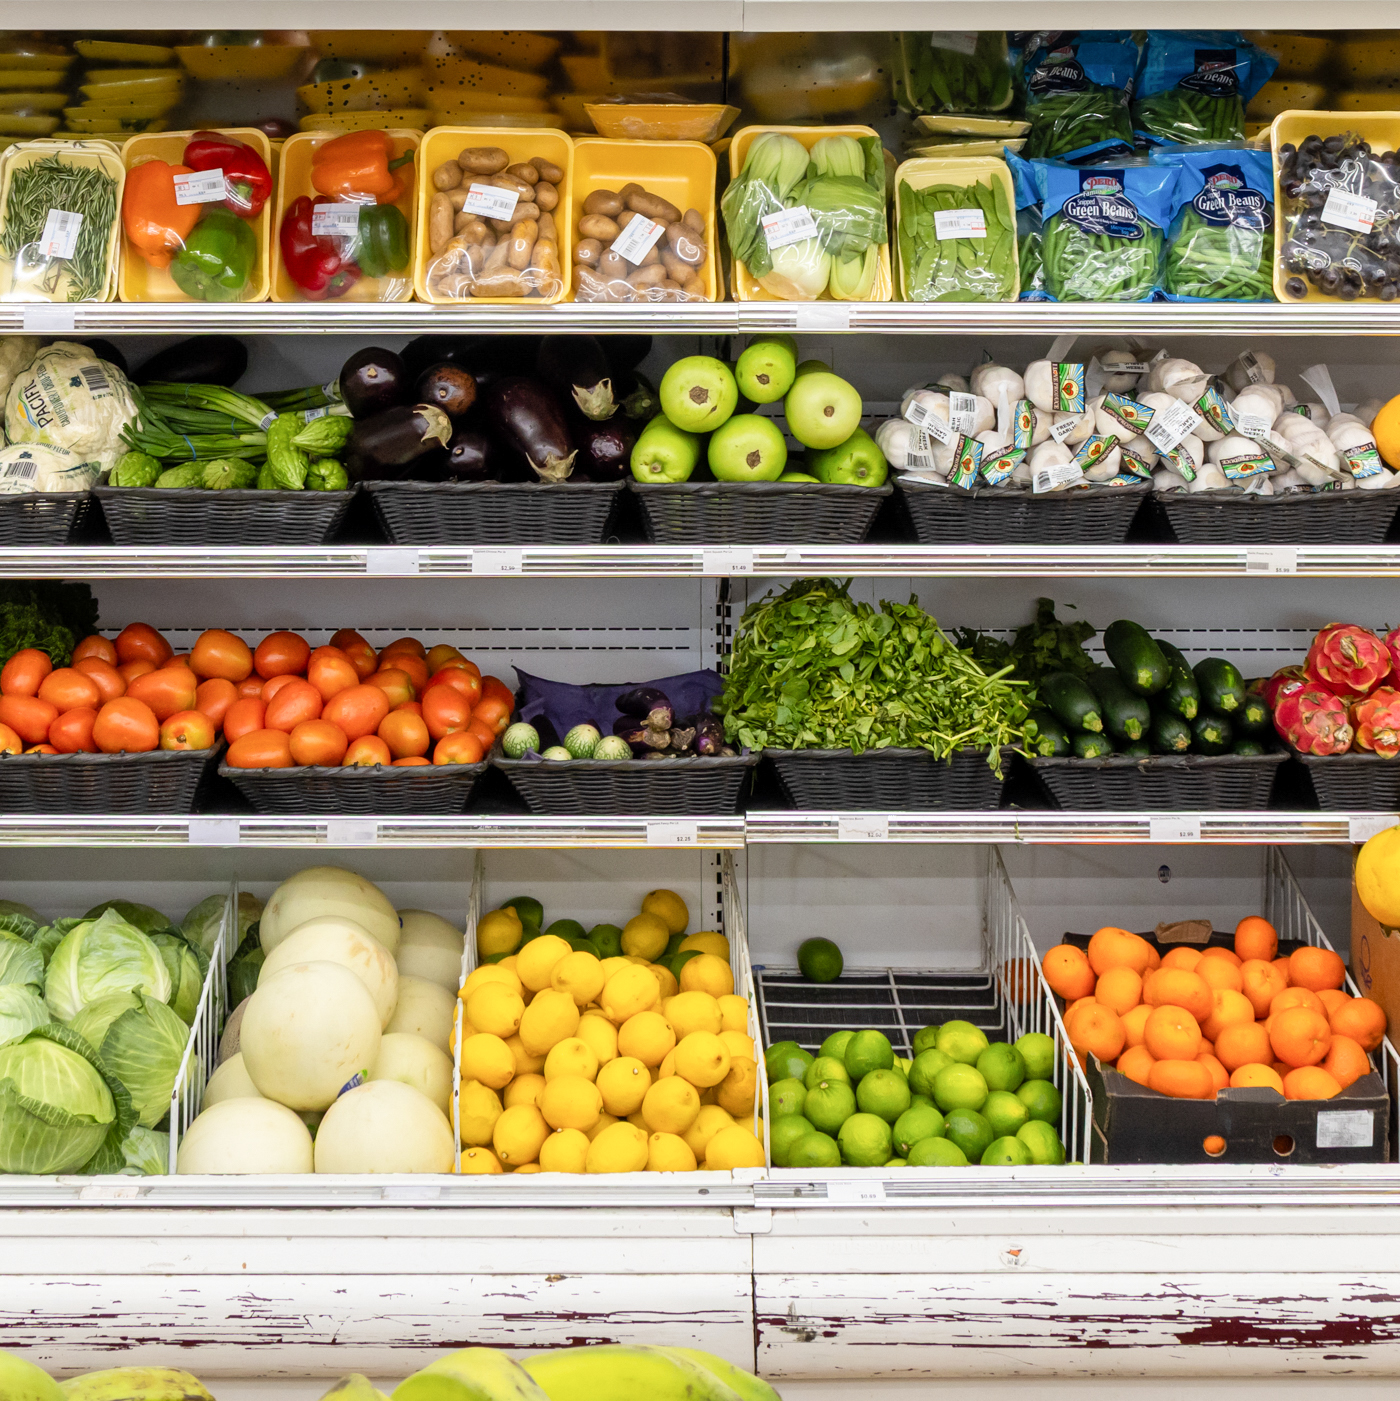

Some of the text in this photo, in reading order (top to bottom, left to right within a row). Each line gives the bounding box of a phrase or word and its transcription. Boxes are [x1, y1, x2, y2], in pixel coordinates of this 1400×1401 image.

[1068, 202, 1134, 219] Green Beans
[1199, 194, 1261, 211] Green Beans
